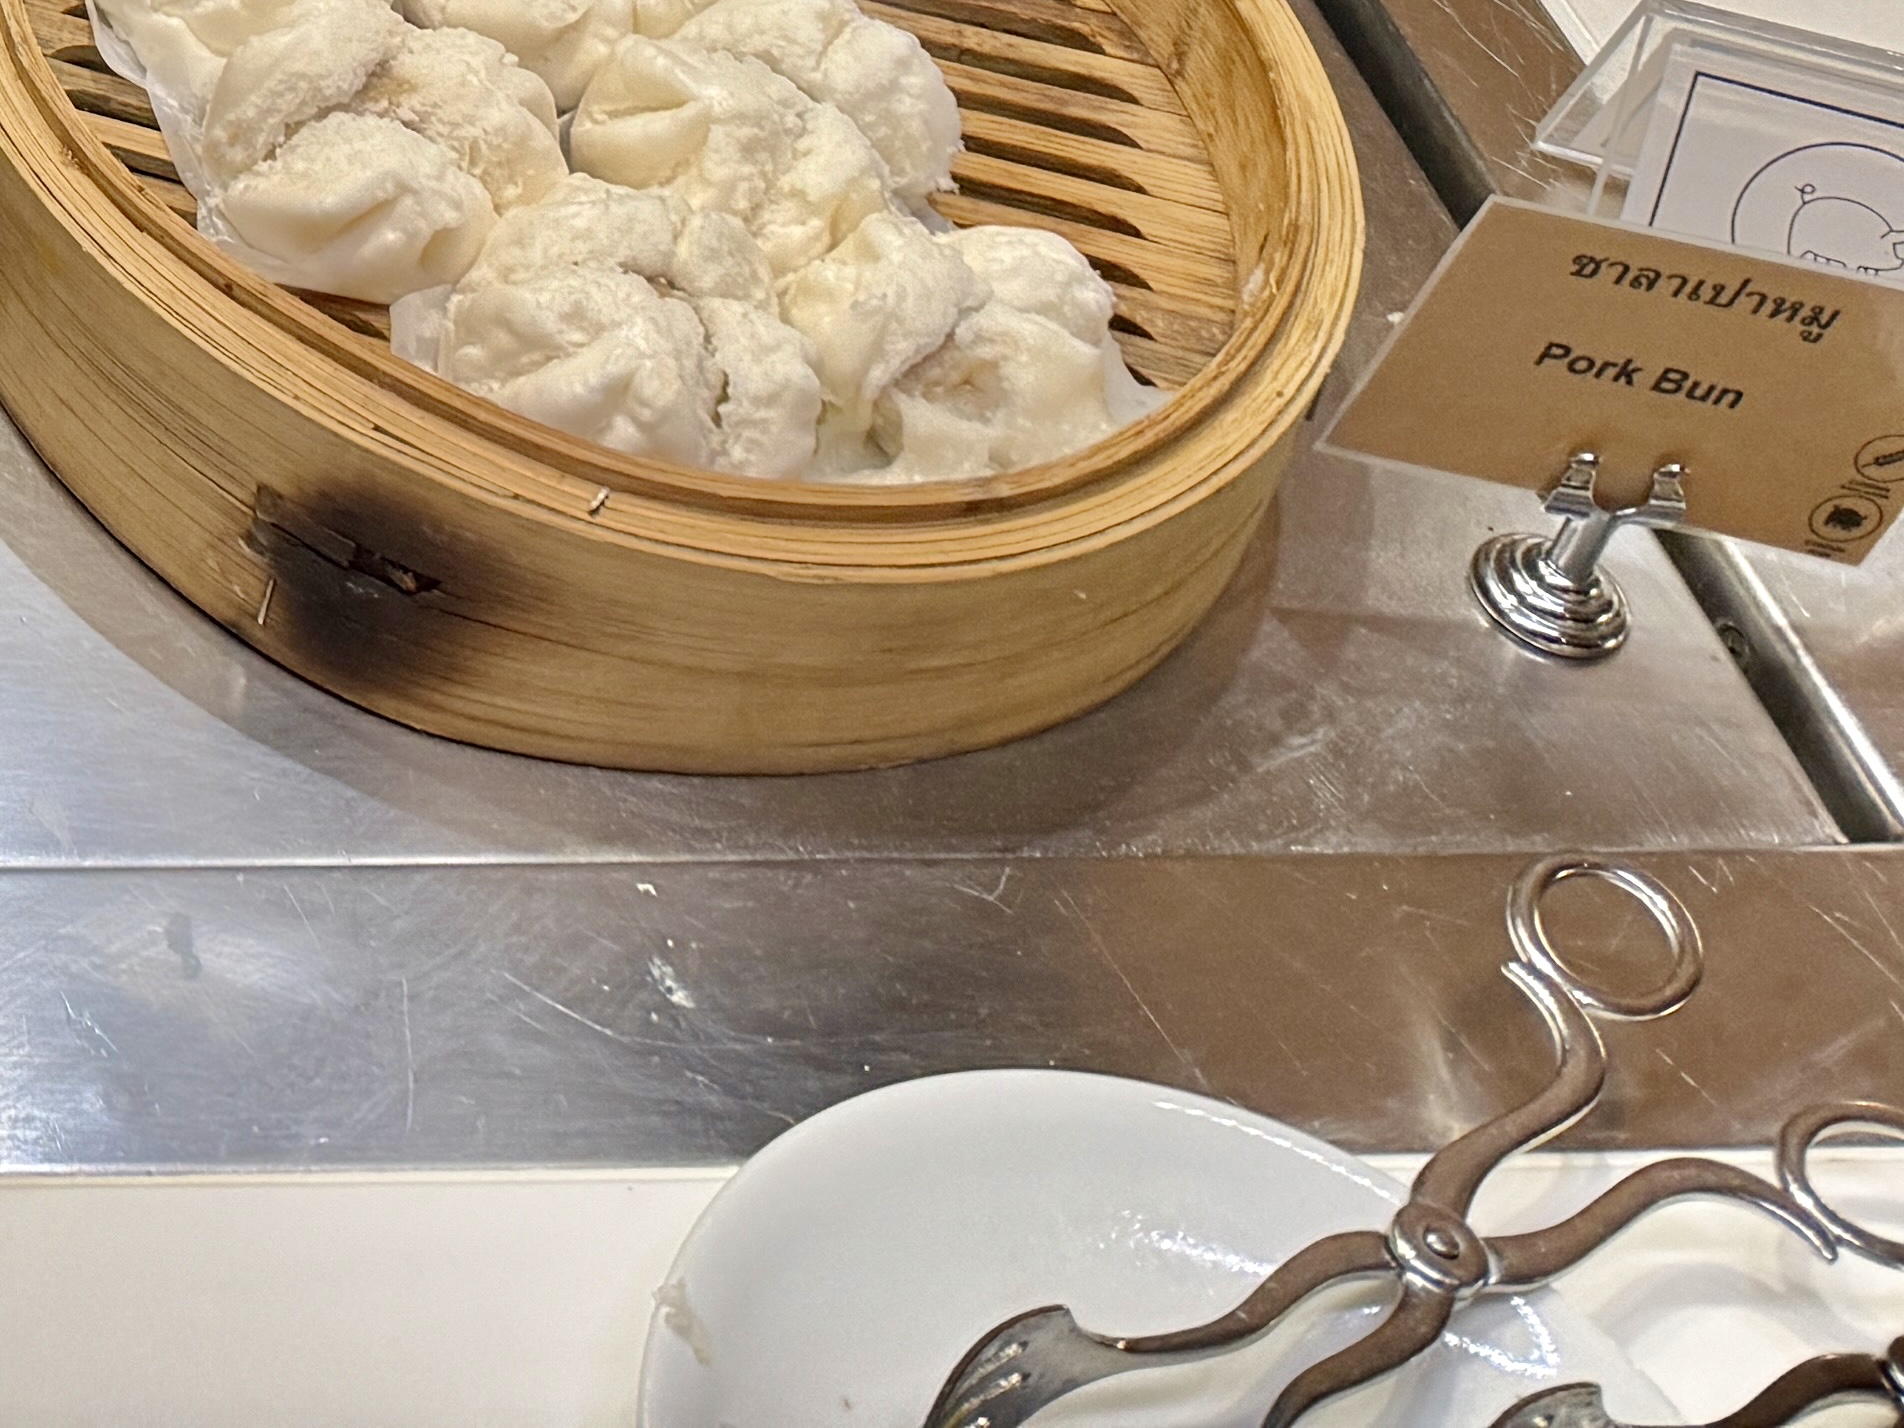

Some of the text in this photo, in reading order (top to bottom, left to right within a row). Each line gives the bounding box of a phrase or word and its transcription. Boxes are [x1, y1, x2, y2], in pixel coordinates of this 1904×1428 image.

[1569, 252, 1841, 344] ซาลาเปาหมู
[1533, 341, 1744, 410] Pork Bun
